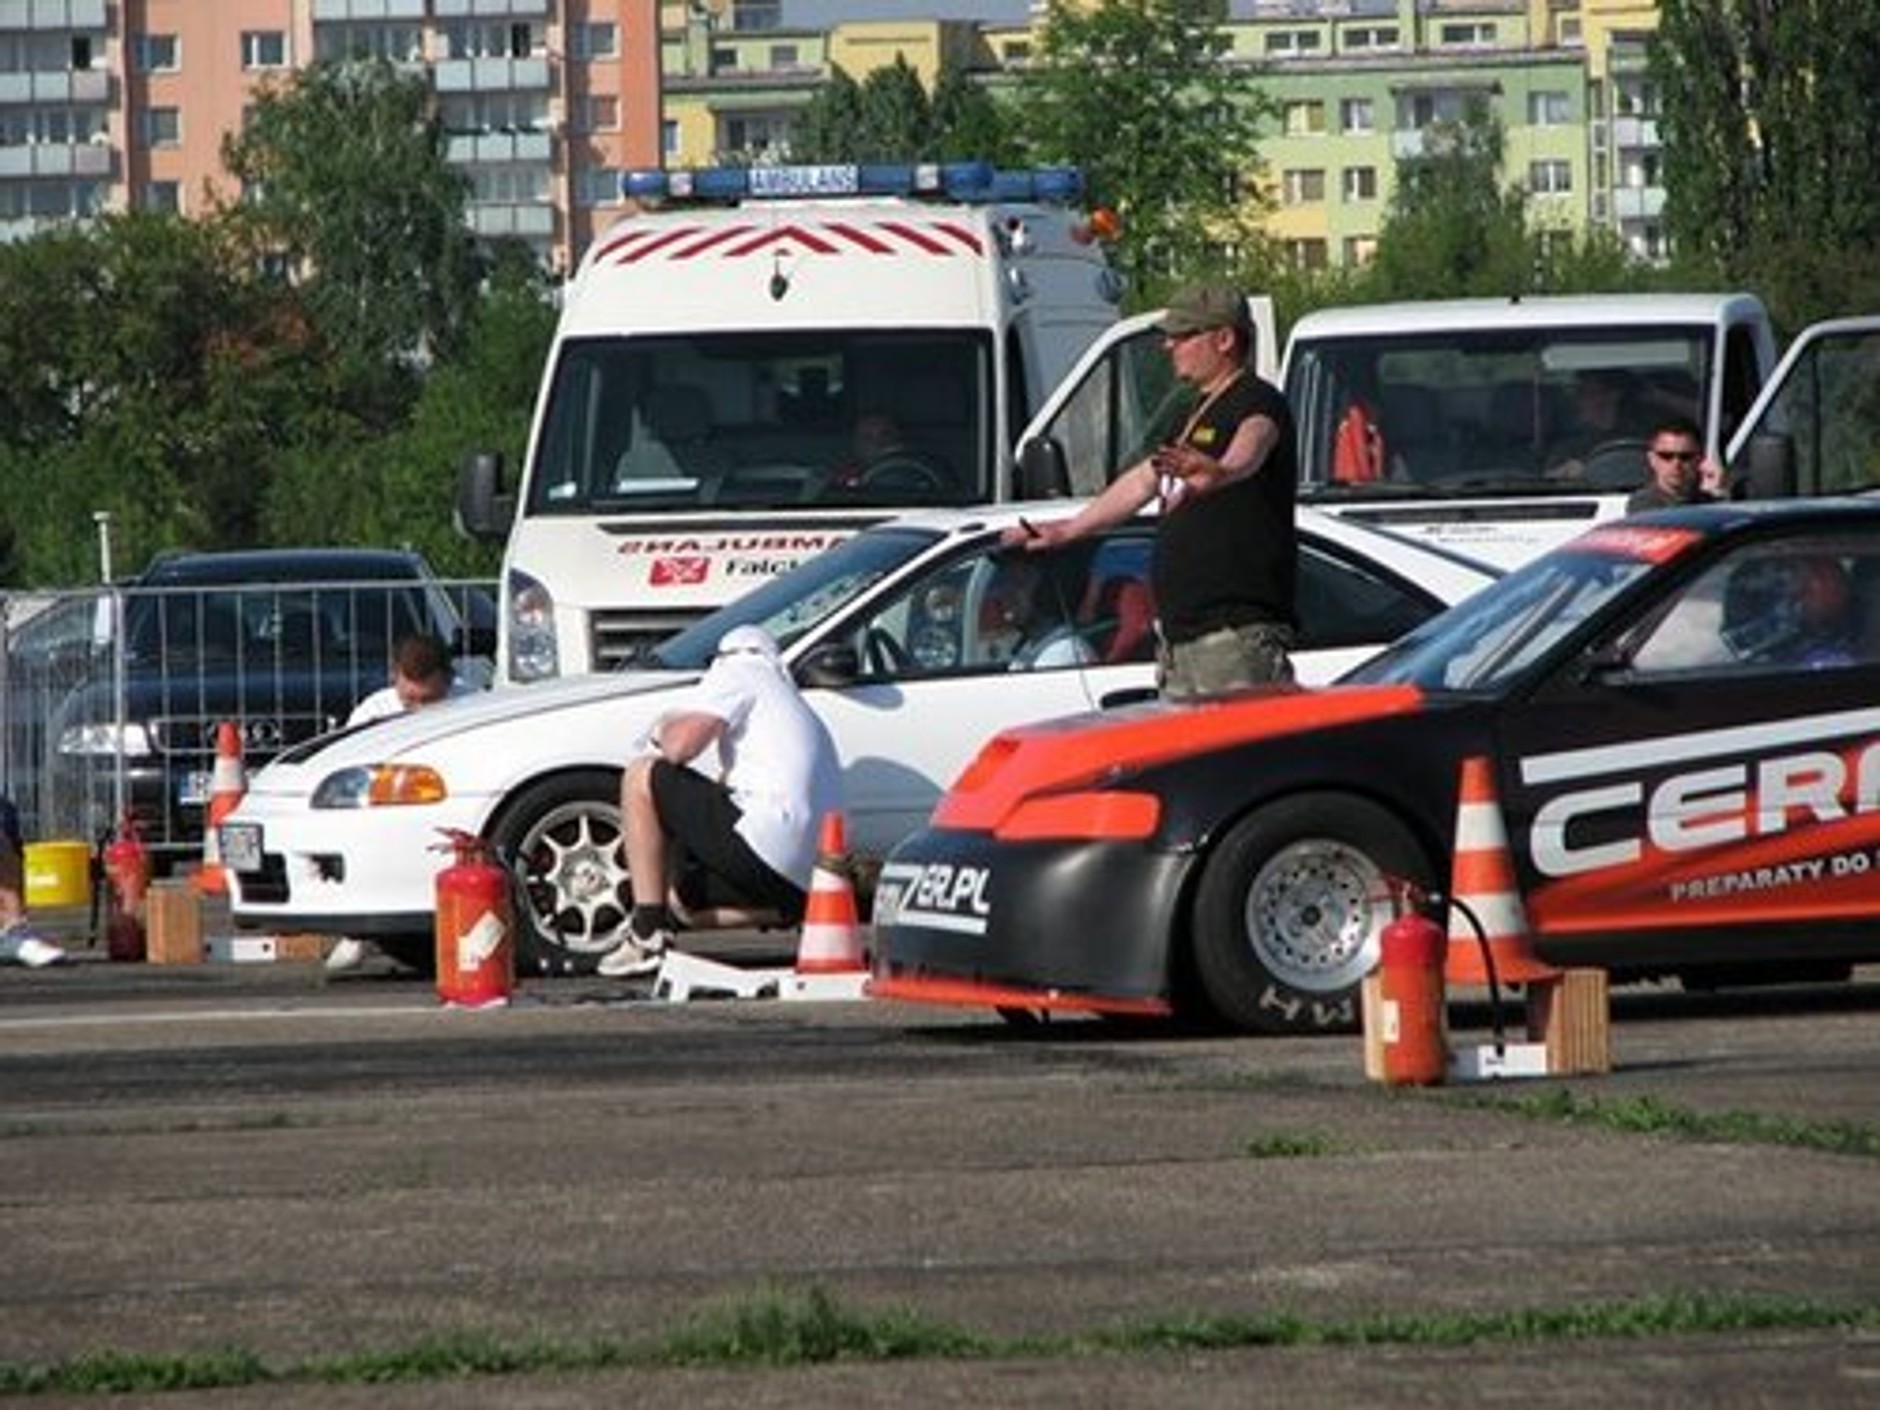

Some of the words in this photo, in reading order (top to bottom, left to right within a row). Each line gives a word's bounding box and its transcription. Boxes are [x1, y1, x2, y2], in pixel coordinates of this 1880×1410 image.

[1530, 739, 1880, 877] CER
[1671, 859, 1824, 902] PREPARATY
[1832, 852, 1871, 877] DO
